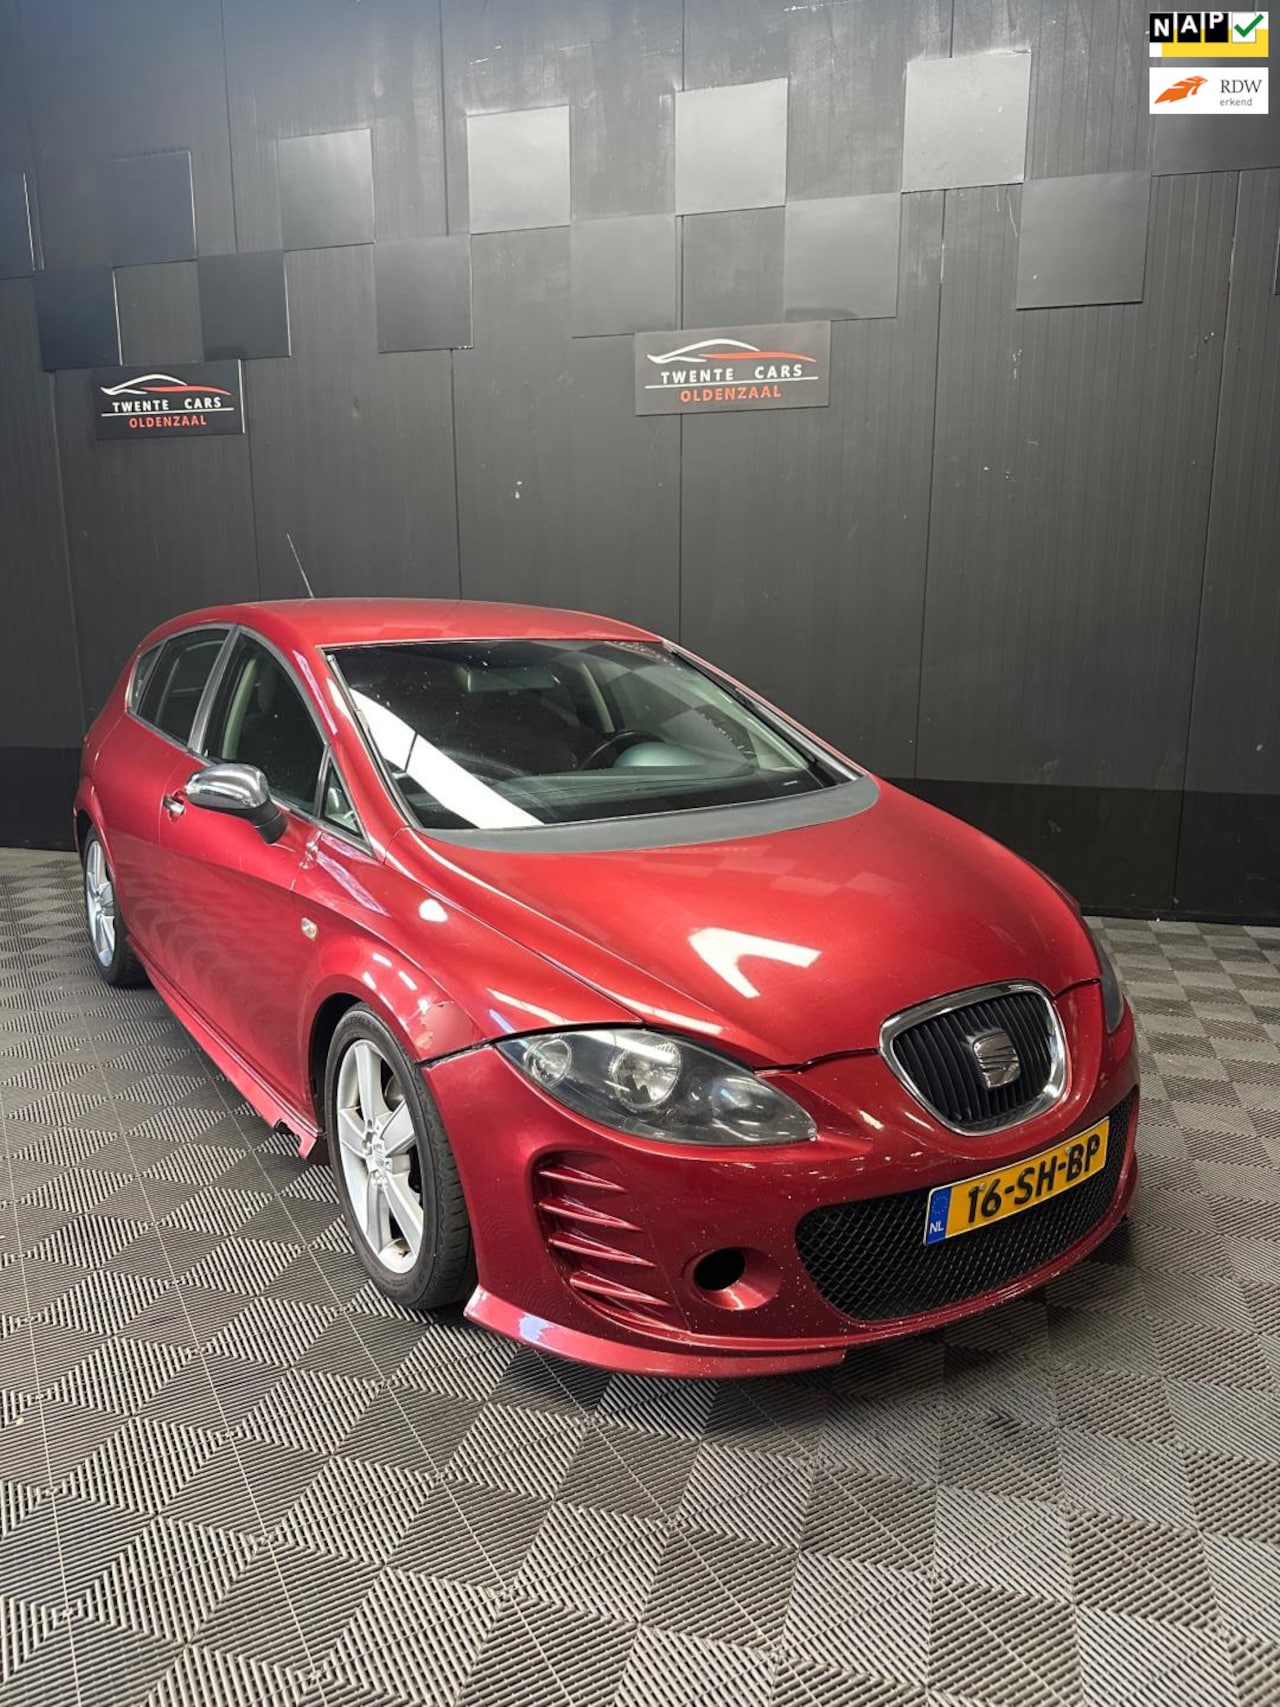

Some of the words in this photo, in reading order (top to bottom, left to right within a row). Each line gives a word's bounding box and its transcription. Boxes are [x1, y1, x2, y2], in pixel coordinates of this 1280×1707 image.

[661, 368, 734, 384] TWENTE
[754, 364, 803, 379] CARS
[680, 385, 781, 403] OLDENZAAL
[112, 399, 169, 413] TWENTE
[184, 396, 222, 409] CARS
[129, 415, 207, 428] OLDENZAAL
[968, 1133, 1100, 1223] 16-SH-BP
[929, 1219, 944, 1235] NL
